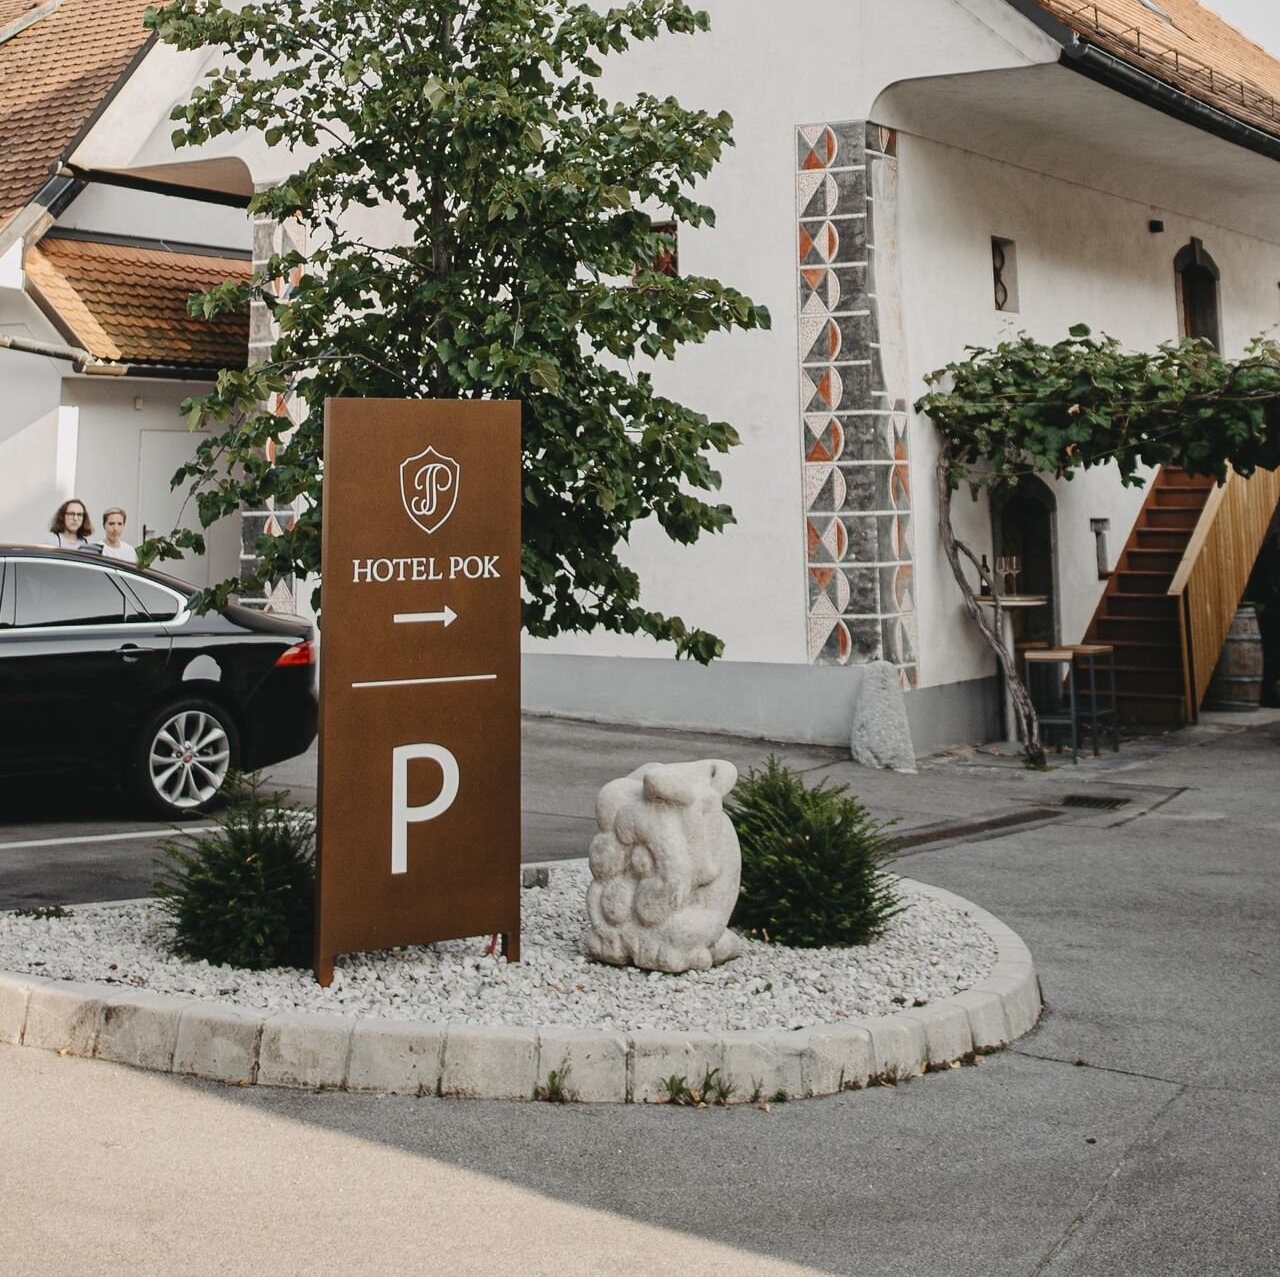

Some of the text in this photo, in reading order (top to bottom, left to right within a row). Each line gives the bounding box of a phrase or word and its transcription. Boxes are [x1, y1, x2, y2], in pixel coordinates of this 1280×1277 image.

[352, 555, 501, 583] HOTEL POK
[391, 743, 460, 874] P
